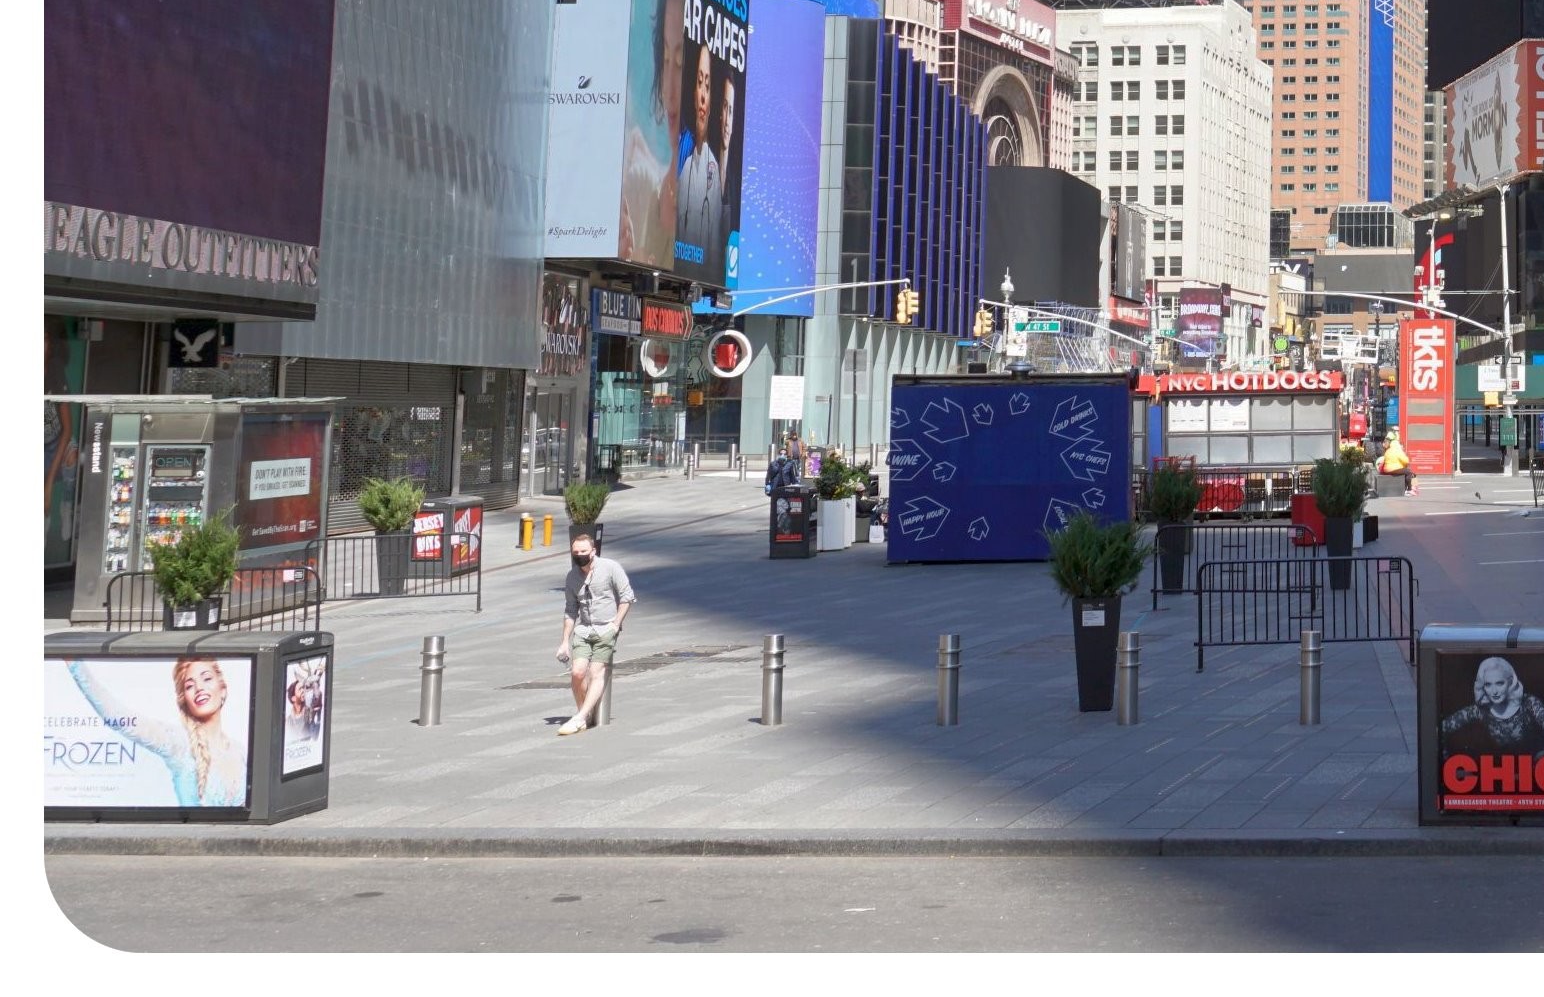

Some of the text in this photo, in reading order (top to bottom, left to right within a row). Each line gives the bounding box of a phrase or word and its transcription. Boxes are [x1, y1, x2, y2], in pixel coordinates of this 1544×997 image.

[704, 5, 747, 74] CAPES
[548, 91, 621, 105] SWAROVSKI
[547, 225, 607, 241] #SparkDelight
[50, 204, 319, 288] EAGLE OUTFITTERS
[602, 290, 625, 316] BLUE
[1413, 324, 1446, 391] tkts
[1168, 377, 1207, 391] NYC
[1053, 418, 1070, 434] COLD
[91, 422, 104, 473] Newsstand
[155, 456, 193, 469] OPEN
[891, 453, 922, 466] WINE
[1069, 450, 1085, 461] NYC
[294, 465, 307, 476] FIRE
[413, 513, 444, 534] JERSEY
[903, 512, 925, 527] HAPPY
[103, 716, 137, 727] MAGIC
